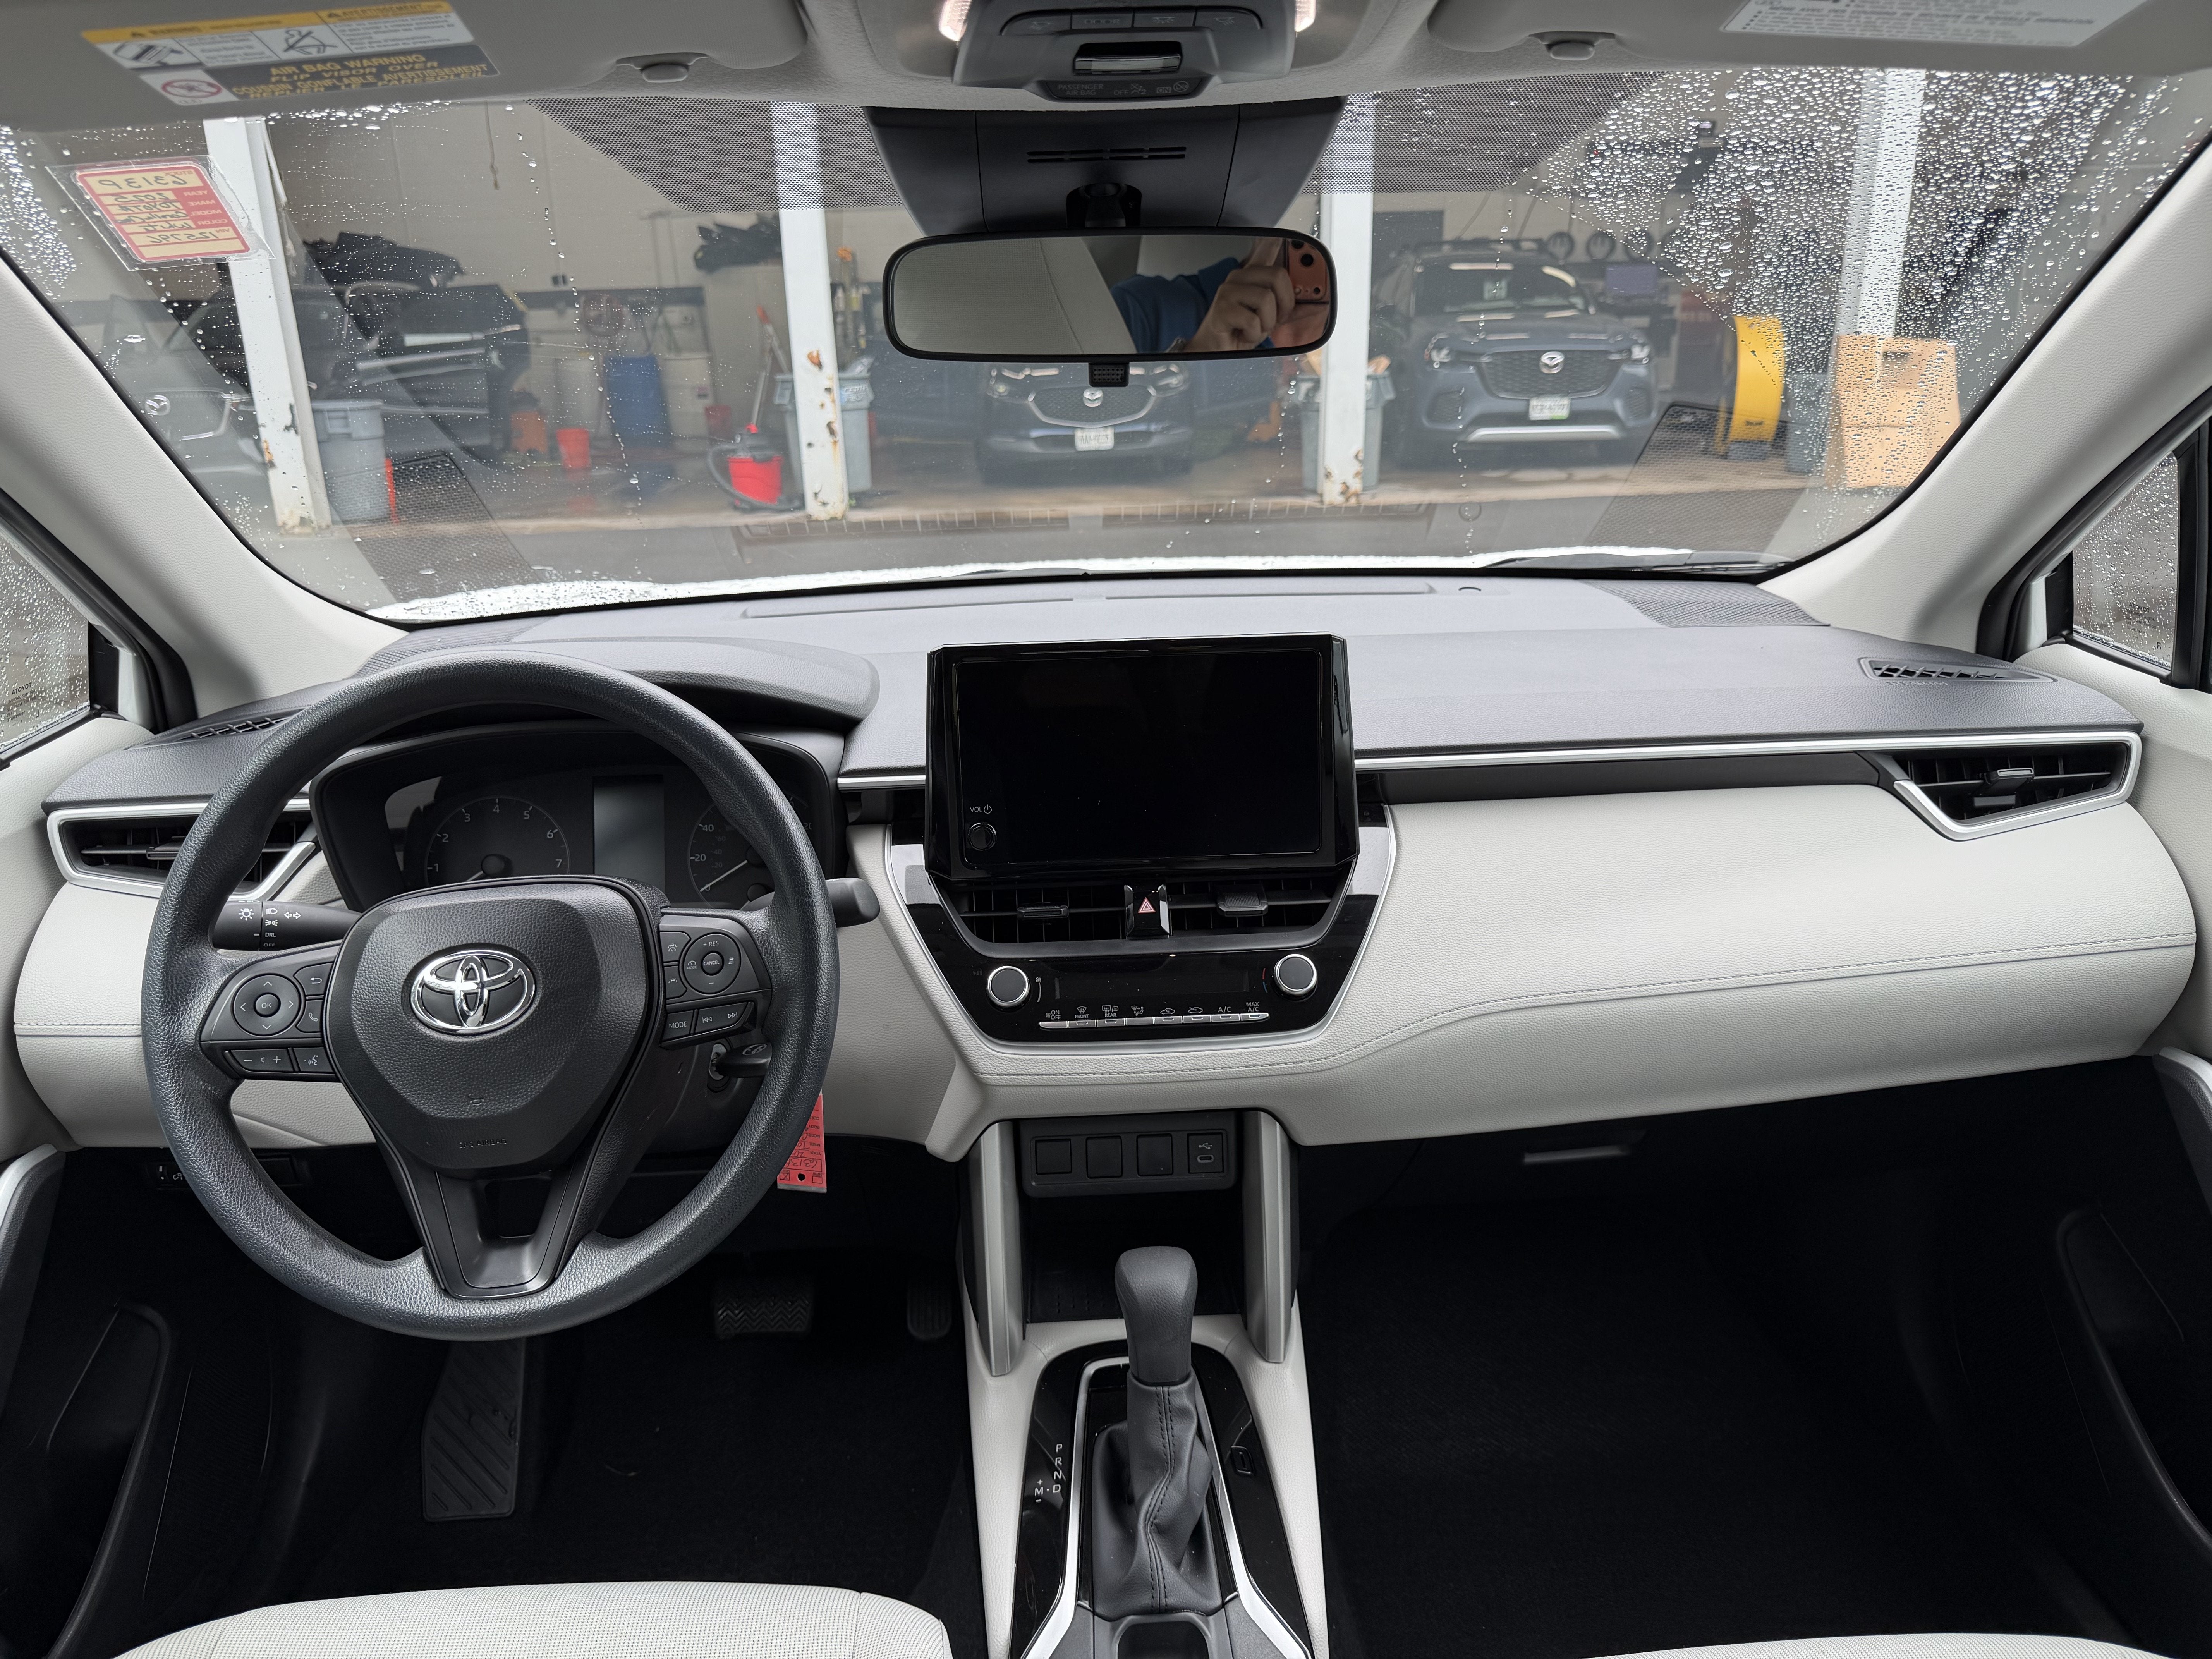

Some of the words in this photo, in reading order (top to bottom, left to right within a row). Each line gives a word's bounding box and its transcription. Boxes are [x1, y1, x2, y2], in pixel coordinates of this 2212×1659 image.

[271, 65, 300, 76] AIR
[302, 62, 342, 72] BAG
[345, 54, 426, 68] WARNING
[271, 74, 310, 82] FLIP
[322, 67, 377, 77] VISOR
[388, 61, 439, 72] OVER
[232, 81, 291, 95] COUSSIN
[296, 76, 377, 90] GONFLABLE
[382, 64, 488, 81] AVERTISSEMENT
[249, 87, 326, 99] REPLIER
[493, 804, 500, 813] 4
[464, 813, 471, 822] 3
[524, 810, 530, 819] 5
[442, 833, 449, 842] 2
[546, 830, 554, 838] 6
[694, 854, 706, 862] 20
[434, 863, 439, 872] 1
[556, 859, 562, 868] 7
[669, 1020, 687, 1029] MODE
[459, 1141, 474, 1149] SRS
[476, 1138, 507, 1147] AIRBAG
[1056, 1444, 1063, 1452] P
[1055, 1457, 1062, 1466] R
[1054, 1470, 1062, 1479] N
[1034, 1487, 1043, 1495] M
[1053, 1484, 1061, 1493] D
